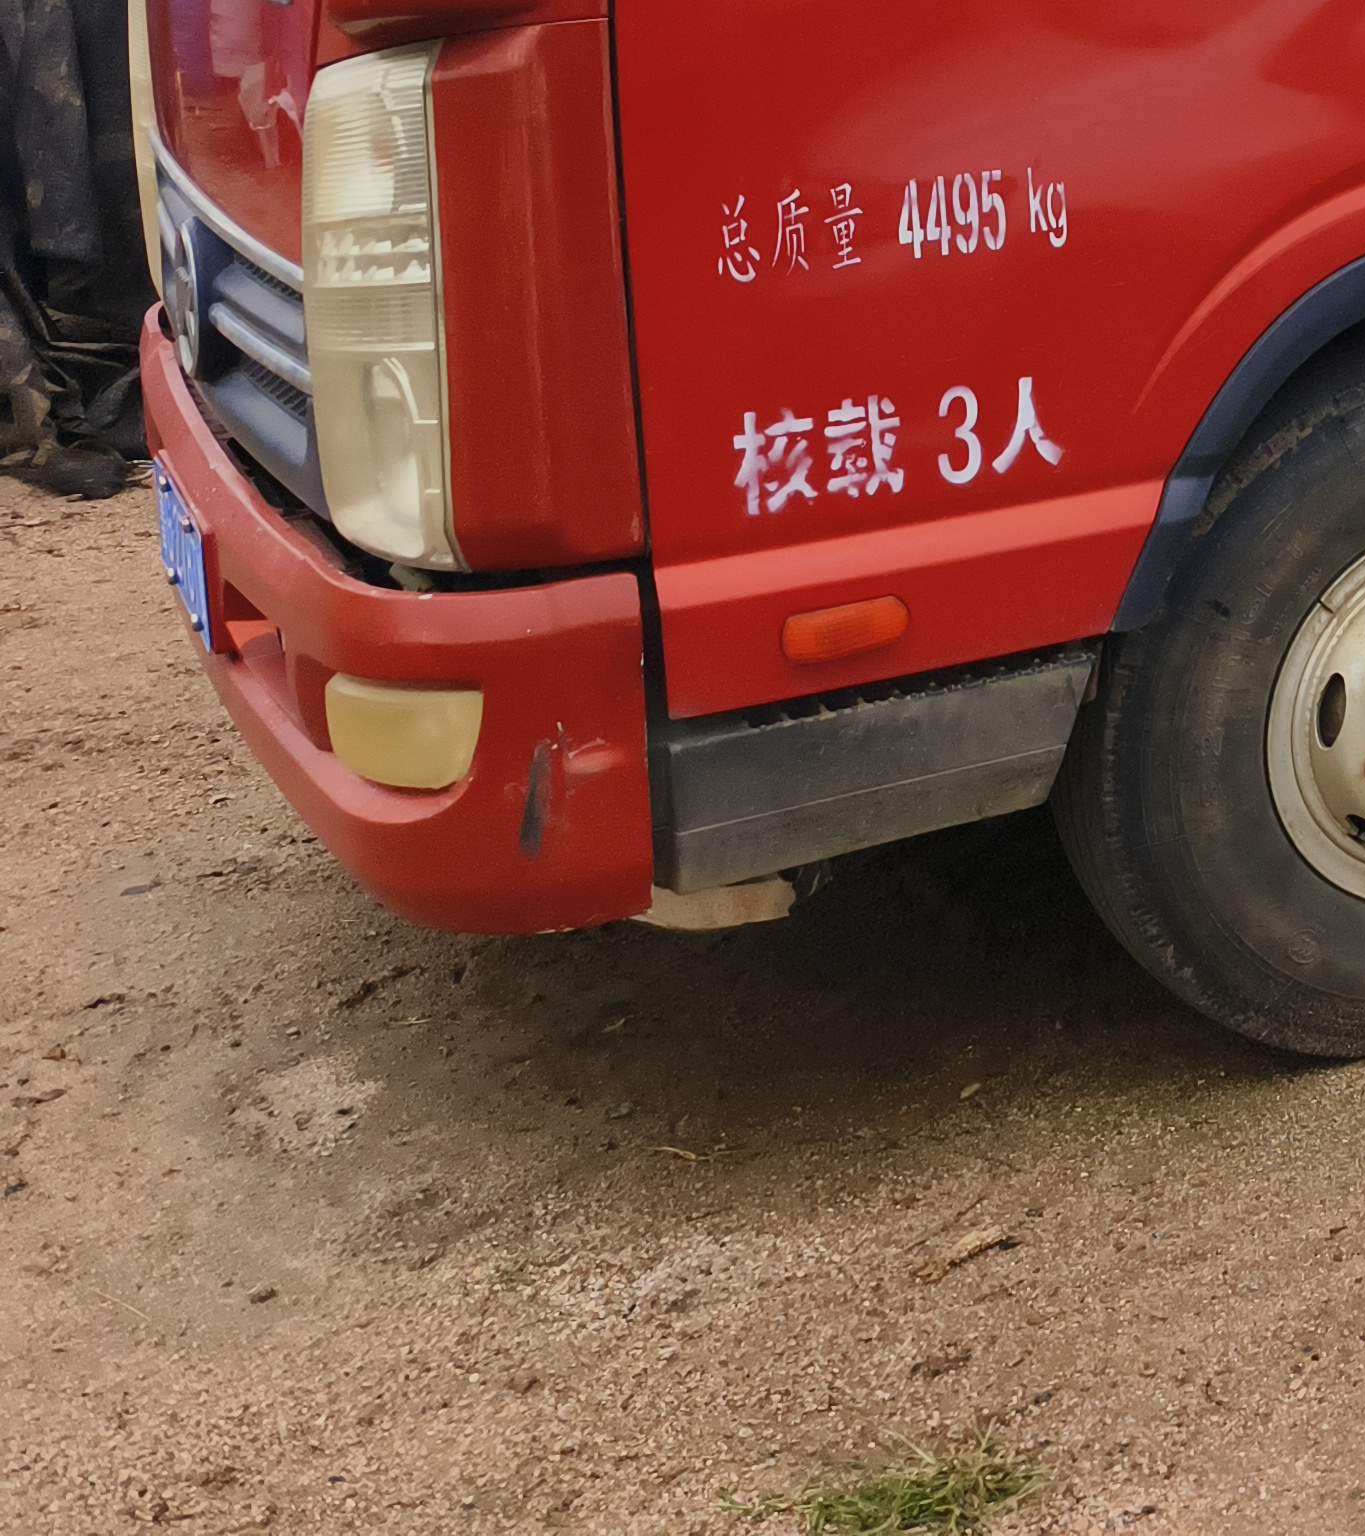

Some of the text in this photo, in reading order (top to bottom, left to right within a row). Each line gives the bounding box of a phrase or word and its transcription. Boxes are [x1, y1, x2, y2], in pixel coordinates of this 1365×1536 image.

[718, 167, 1068, 283] 总质量 4495 kg
[733, 394, 905, 516] 核载
